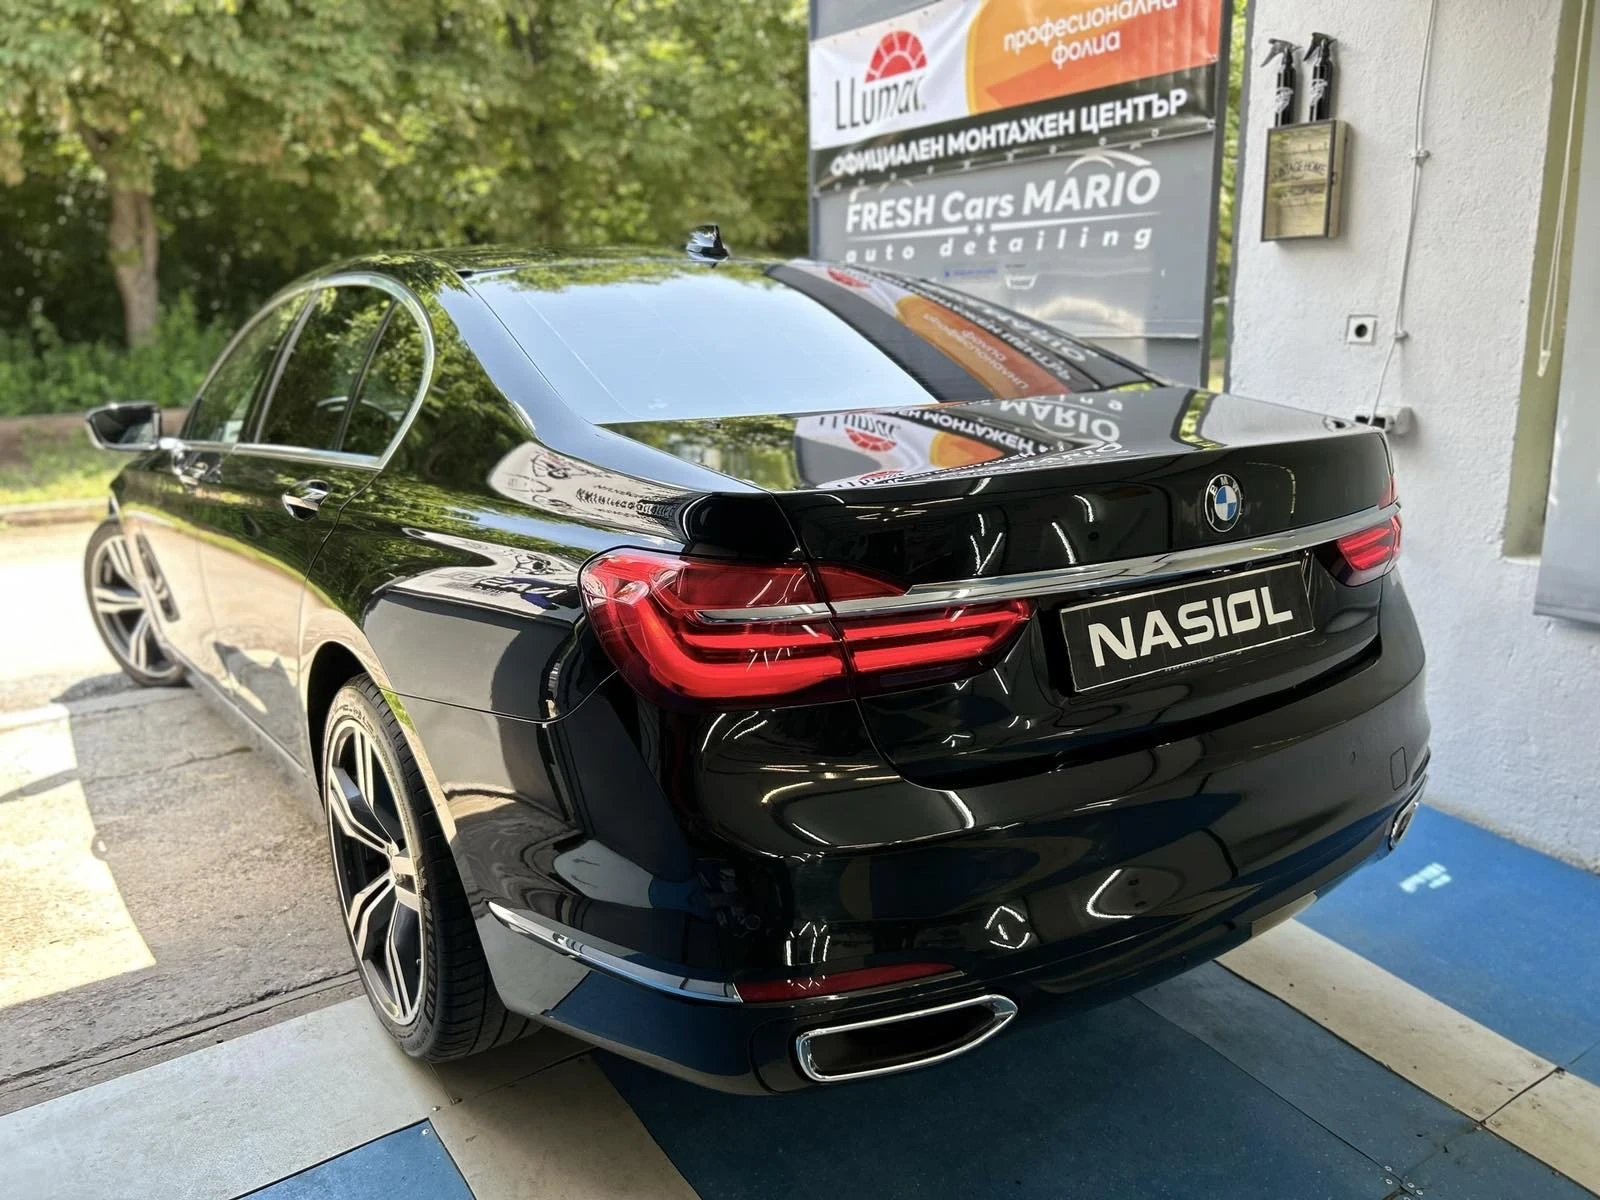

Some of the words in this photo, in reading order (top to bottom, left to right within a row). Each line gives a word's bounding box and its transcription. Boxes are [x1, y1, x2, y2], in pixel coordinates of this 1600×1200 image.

[1052, 31, 1120, 69] фолиа
[830, 135, 945, 176] ОФИЦИАЛЕН
[947, 110, 1075, 155] МОНТАЖЕН
[1080, 89, 1187, 134] ЦЕНТЪР
[846, 190, 936, 232] FRESH
[942, 191, 1014, 224] Cars
[1023, 167, 1160, 216] MARIO
[845, 243, 915, 263] auto
[939, 226, 1151, 257] detailing
[1210, 476, 1239, 496] BMW
[1088, 586, 1293, 667] NASIOL
